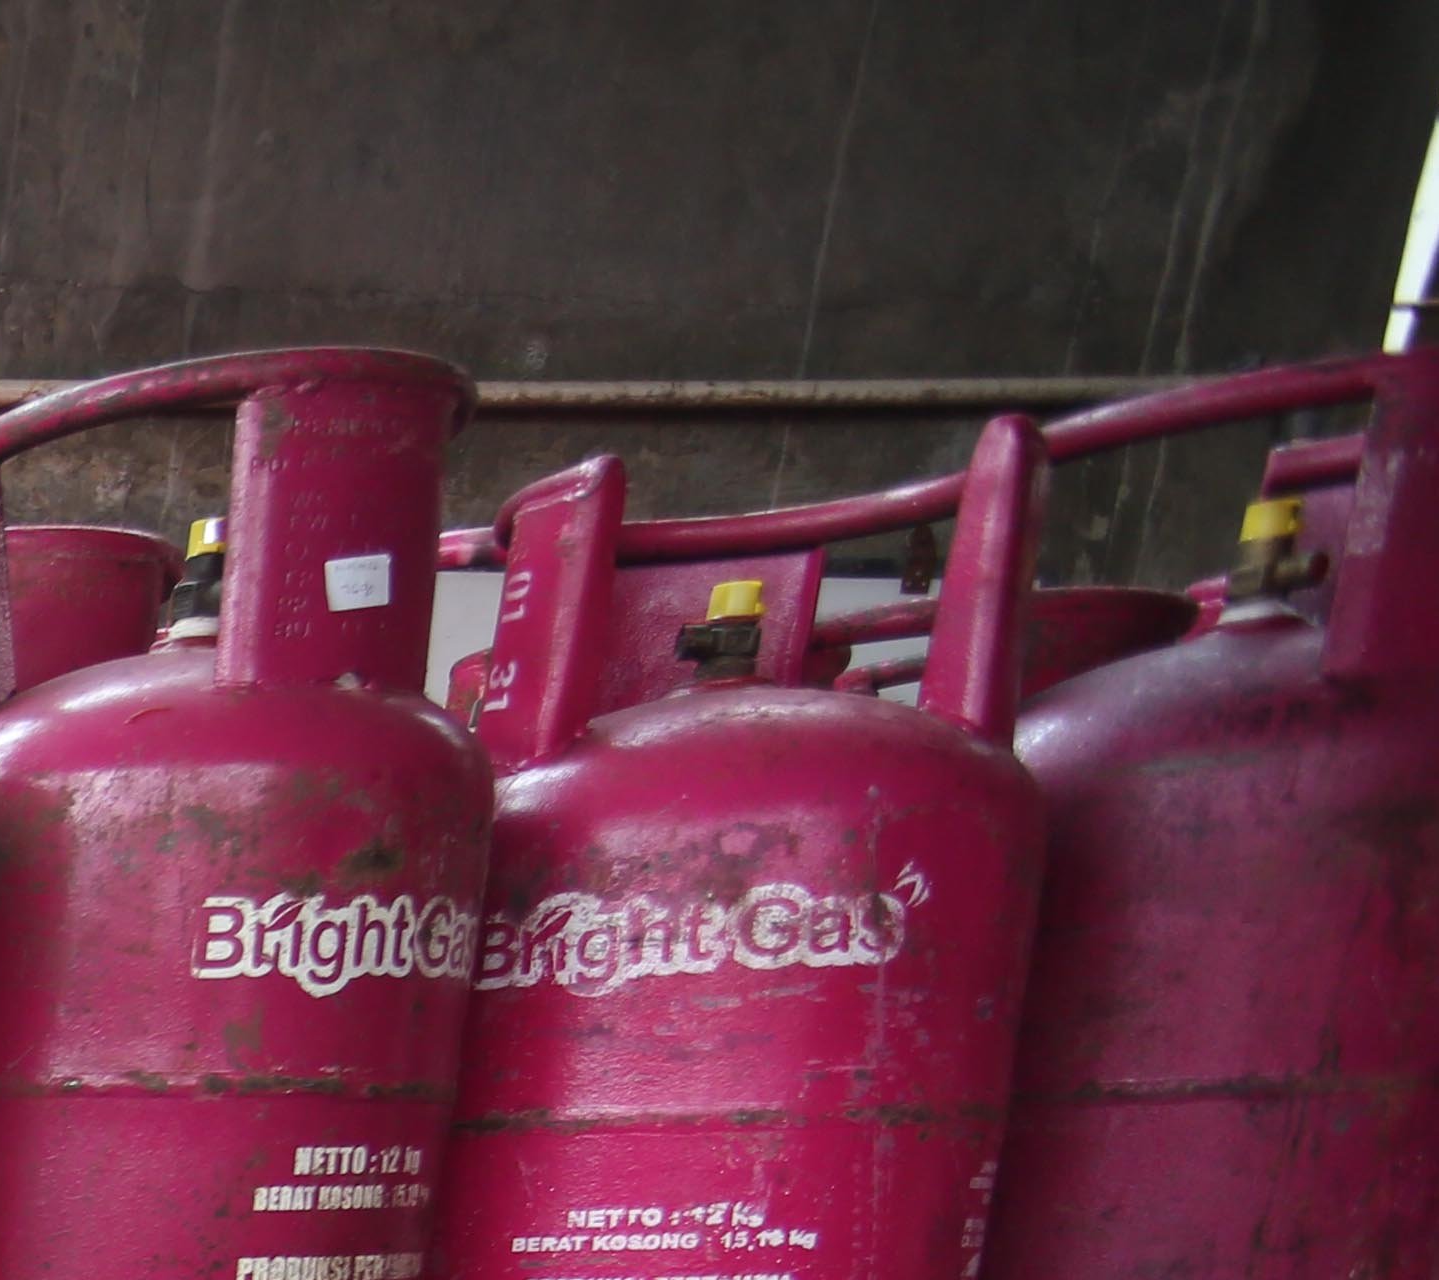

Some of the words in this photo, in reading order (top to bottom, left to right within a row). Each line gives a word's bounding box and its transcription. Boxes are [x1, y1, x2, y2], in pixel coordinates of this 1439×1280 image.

[192, 893, 409, 996] Bright
[475, 892, 722, 996] Bright
[726, 884, 905, 968] Gas
[293, 1147, 369, 1176] NETTO
[253, 1187, 315, 1211] BERAT
[567, 1207, 663, 1229] NETTO
[511, 1236, 588, 1253] BERAT
[591, 1232, 700, 1251] KOSONG
